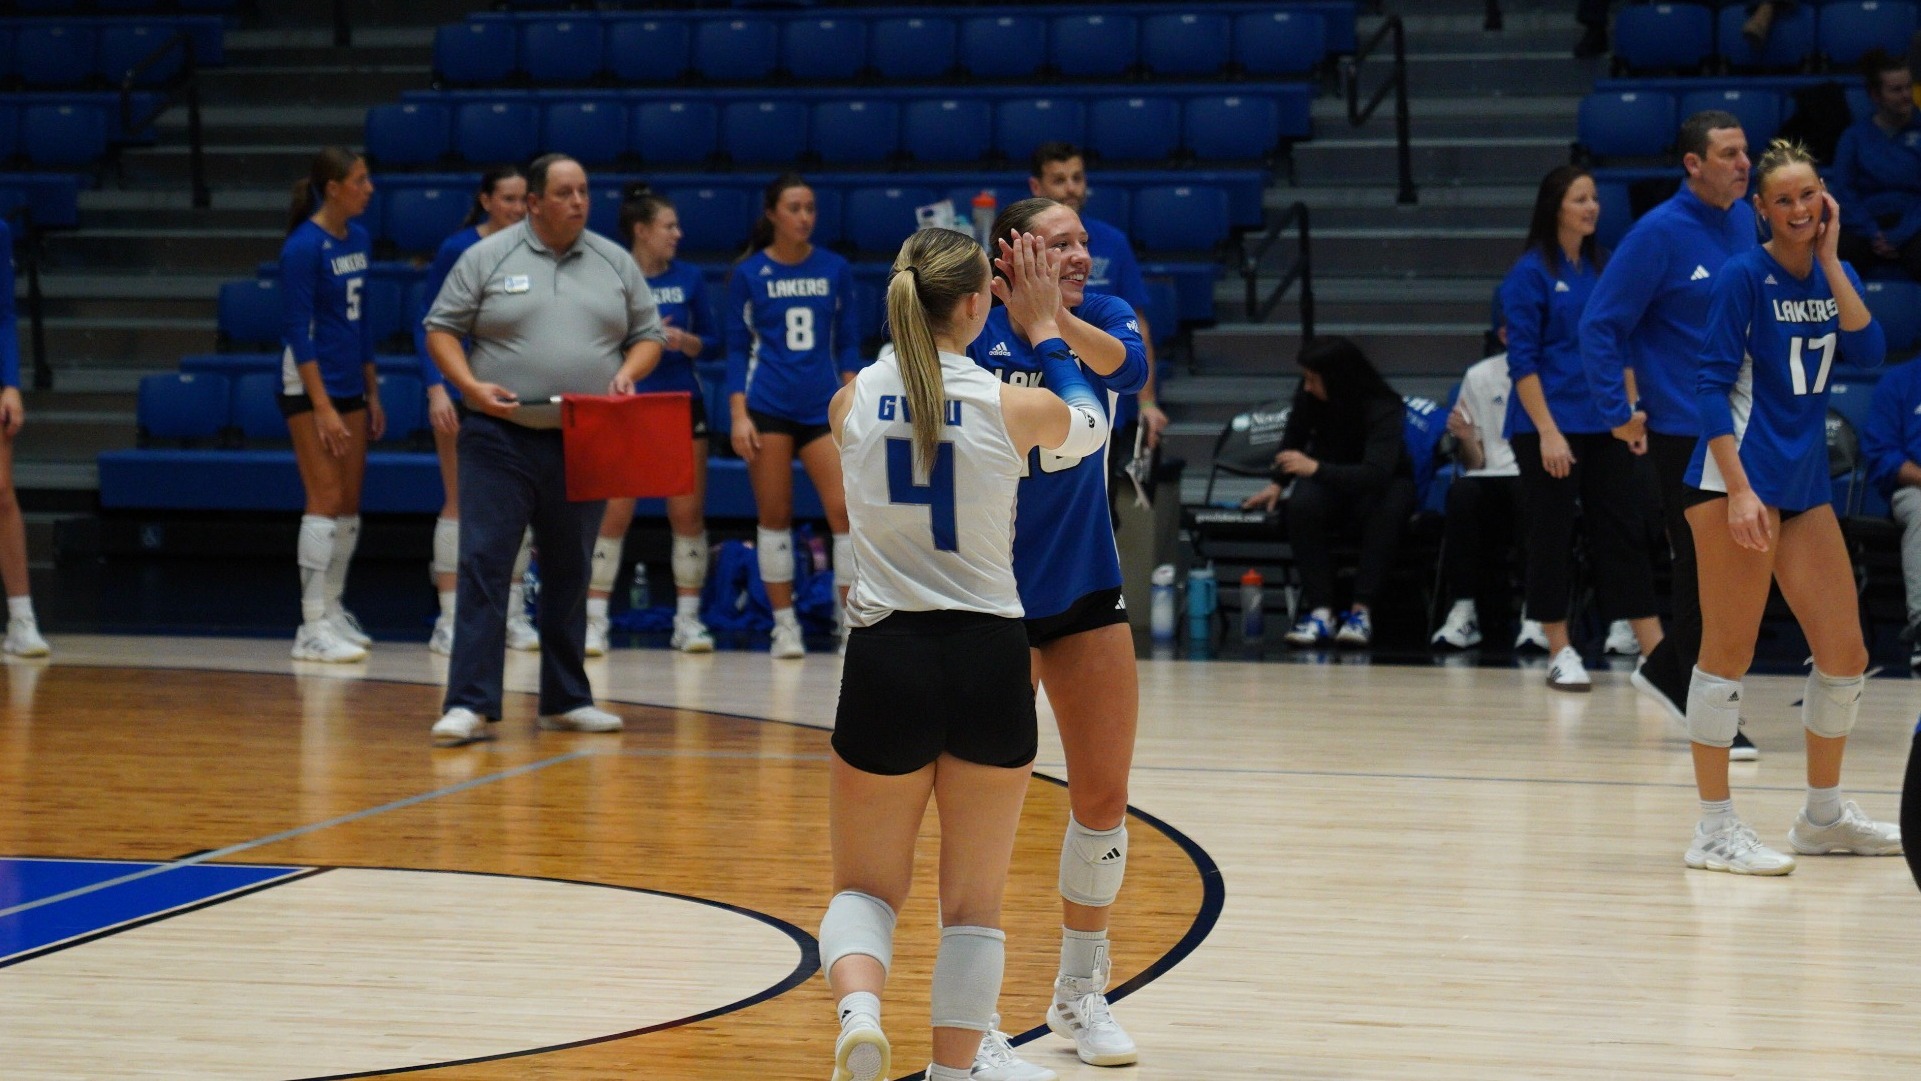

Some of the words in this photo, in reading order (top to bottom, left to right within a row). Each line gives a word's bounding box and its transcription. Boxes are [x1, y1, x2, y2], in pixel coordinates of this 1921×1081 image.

[345, 277, 363, 321] 5
[650, 286, 685, 304] ERS
[766, 277, 829, 298] LAKERS
[785, 307, 814, 351] 8
[1773, 298, 1838, 322] LAKERS
[1789, 332, 1837, 395] 17
[878, 395, 962, 427] GU
[884, 436, 960, 553] 4
